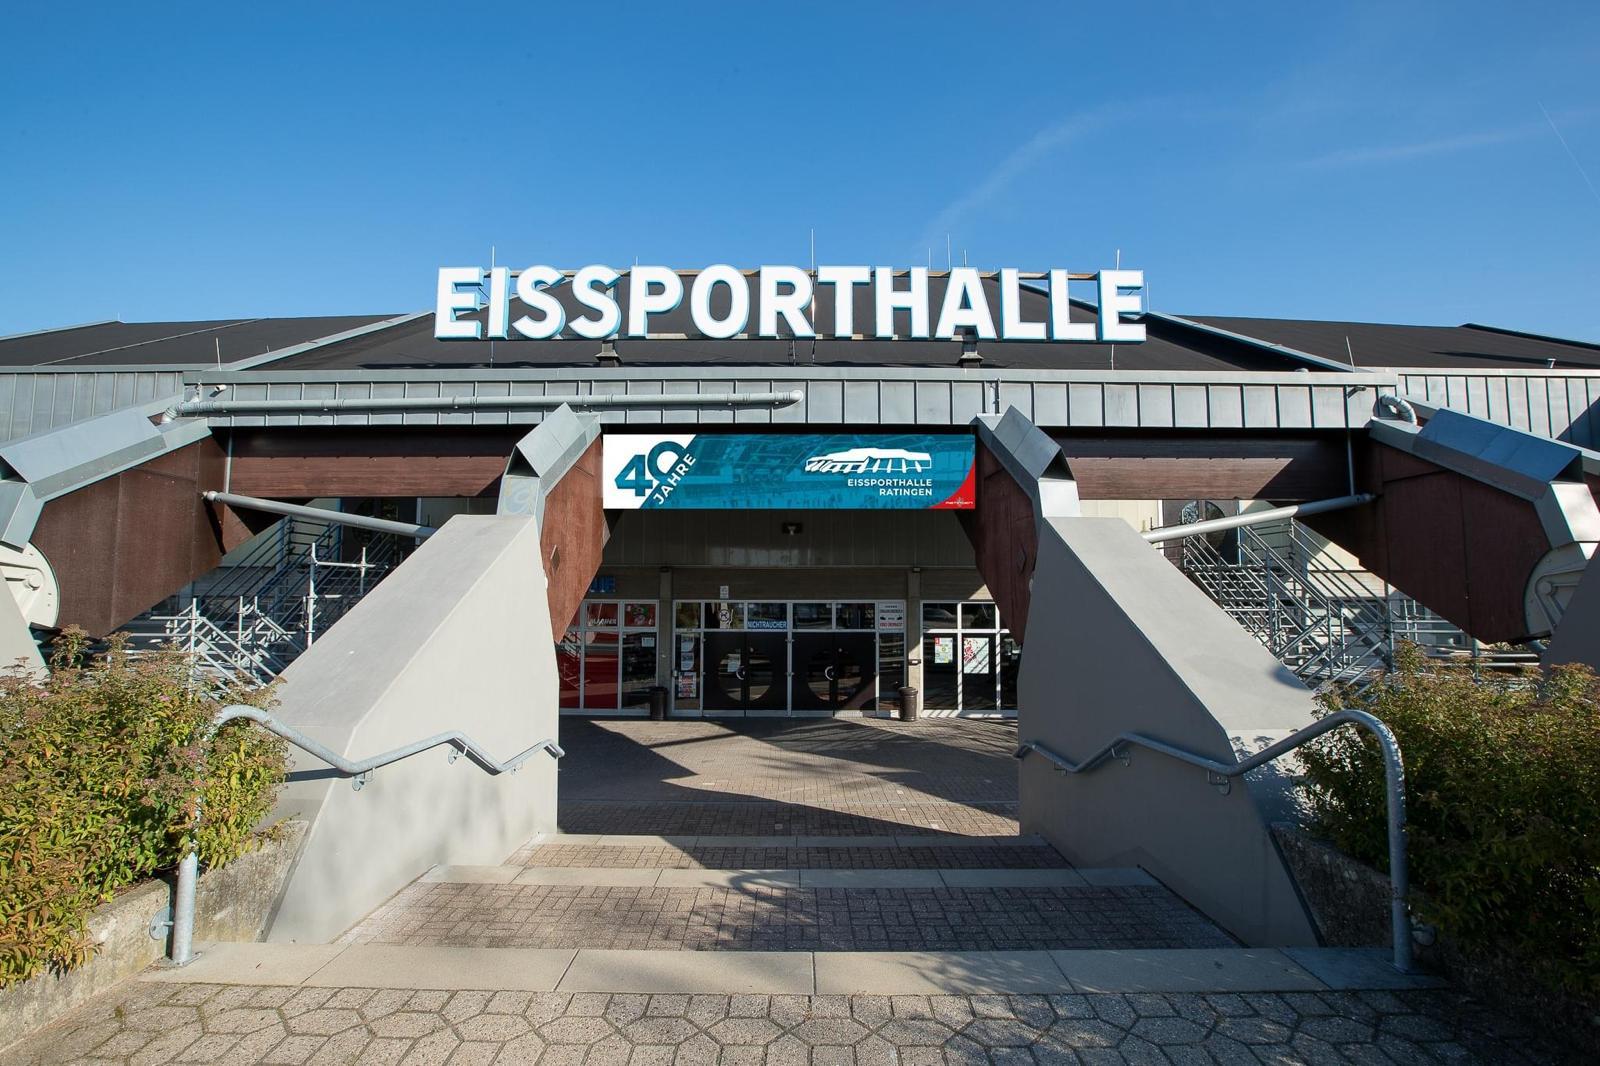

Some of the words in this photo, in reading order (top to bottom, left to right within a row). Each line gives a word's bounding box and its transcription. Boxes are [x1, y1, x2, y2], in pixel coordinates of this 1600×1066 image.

[434, 264, 1149, 343] EISSPORTHALLE
[614, 441, 685, 497] 40
[653, 453, 697, 505] JAHRE
[847, 478, 932, 487] EISSPORTHALLE
[879, 488, 933, 496] RATINGEN
[747, 621, 787, 629] NICHTRAUCHER
